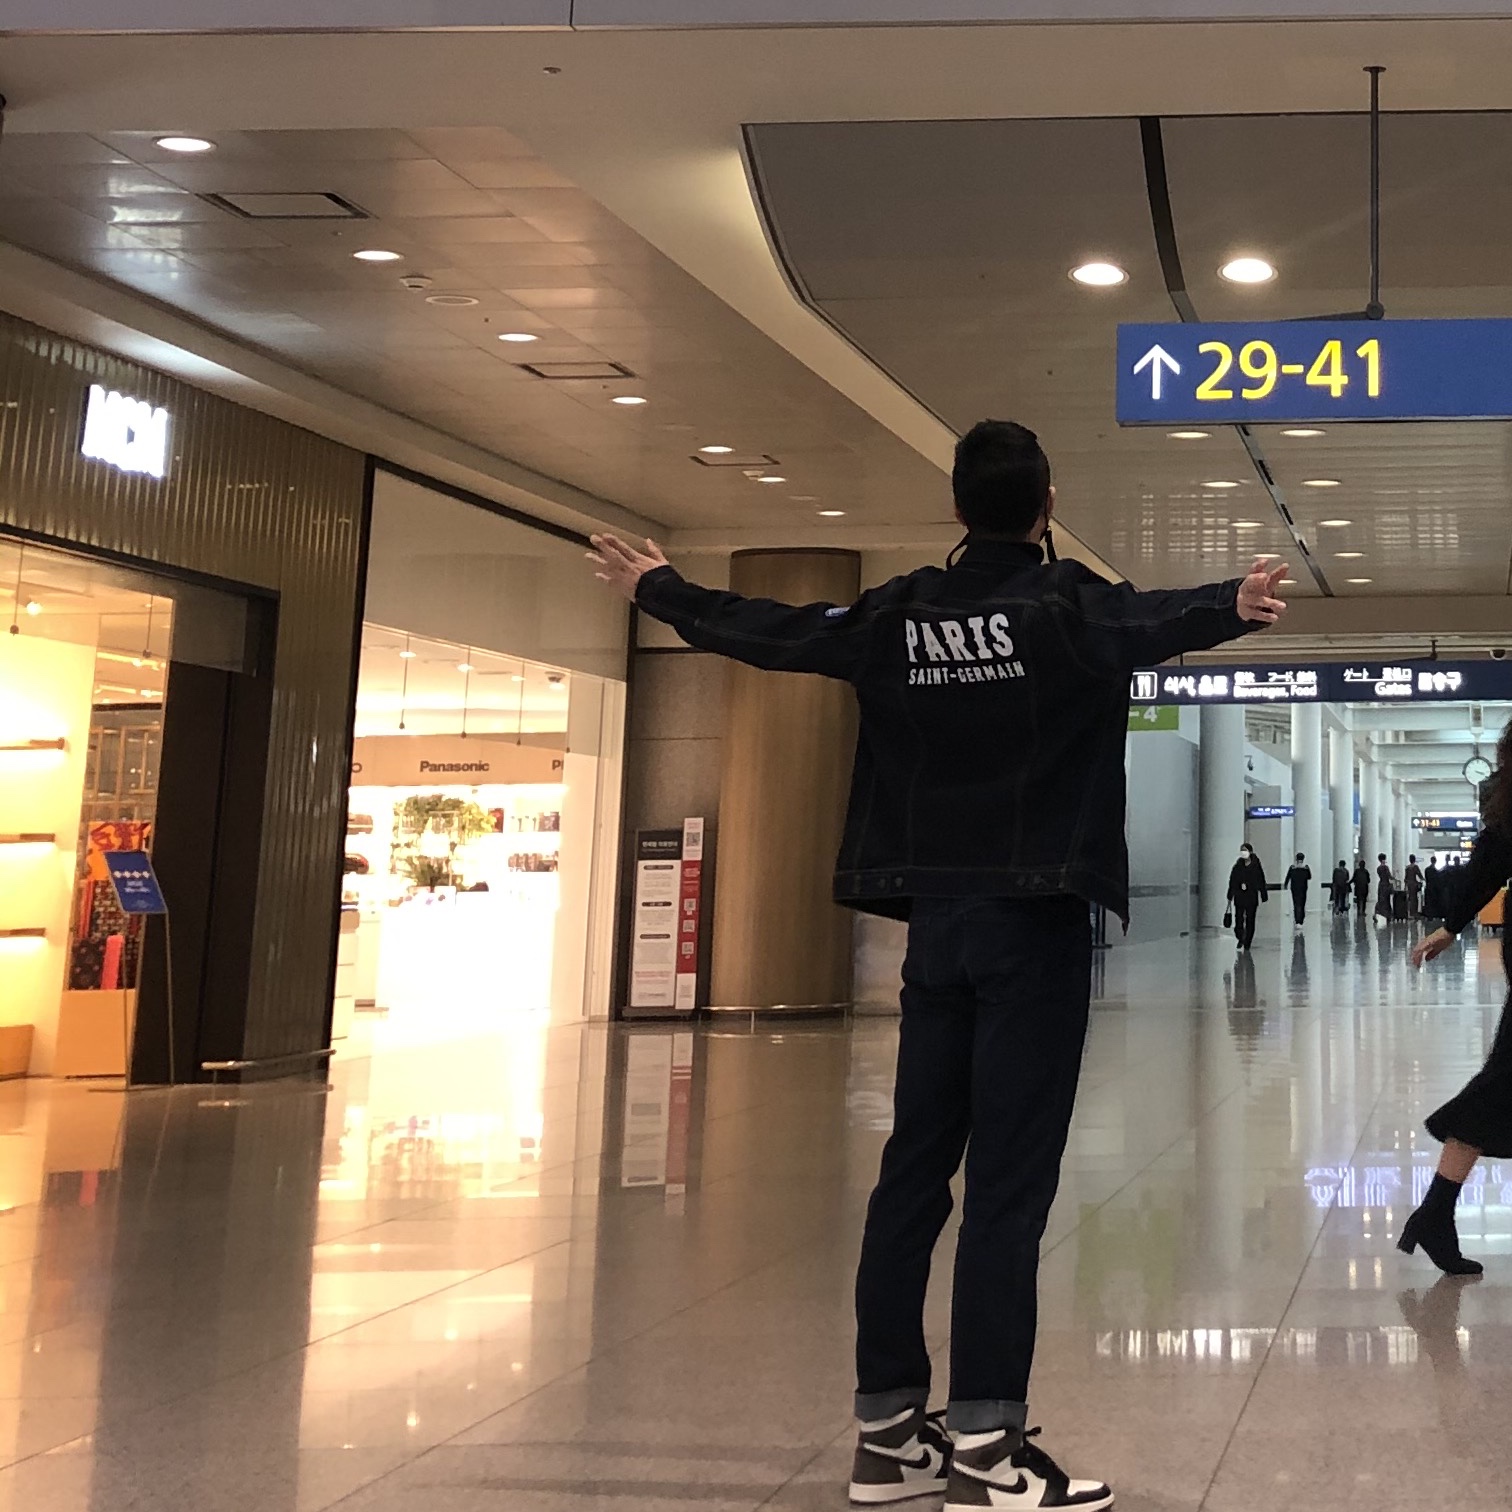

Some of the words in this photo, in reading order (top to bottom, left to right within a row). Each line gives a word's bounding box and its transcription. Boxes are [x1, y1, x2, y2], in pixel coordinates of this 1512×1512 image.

[1195, 338, 1384, 400] 29-41
[905, 613, 1014, 663] PARIS
[908, 660, 1026, 686] SAINT-GERMAIN
[420, 760, 490, 773] Panasonic
